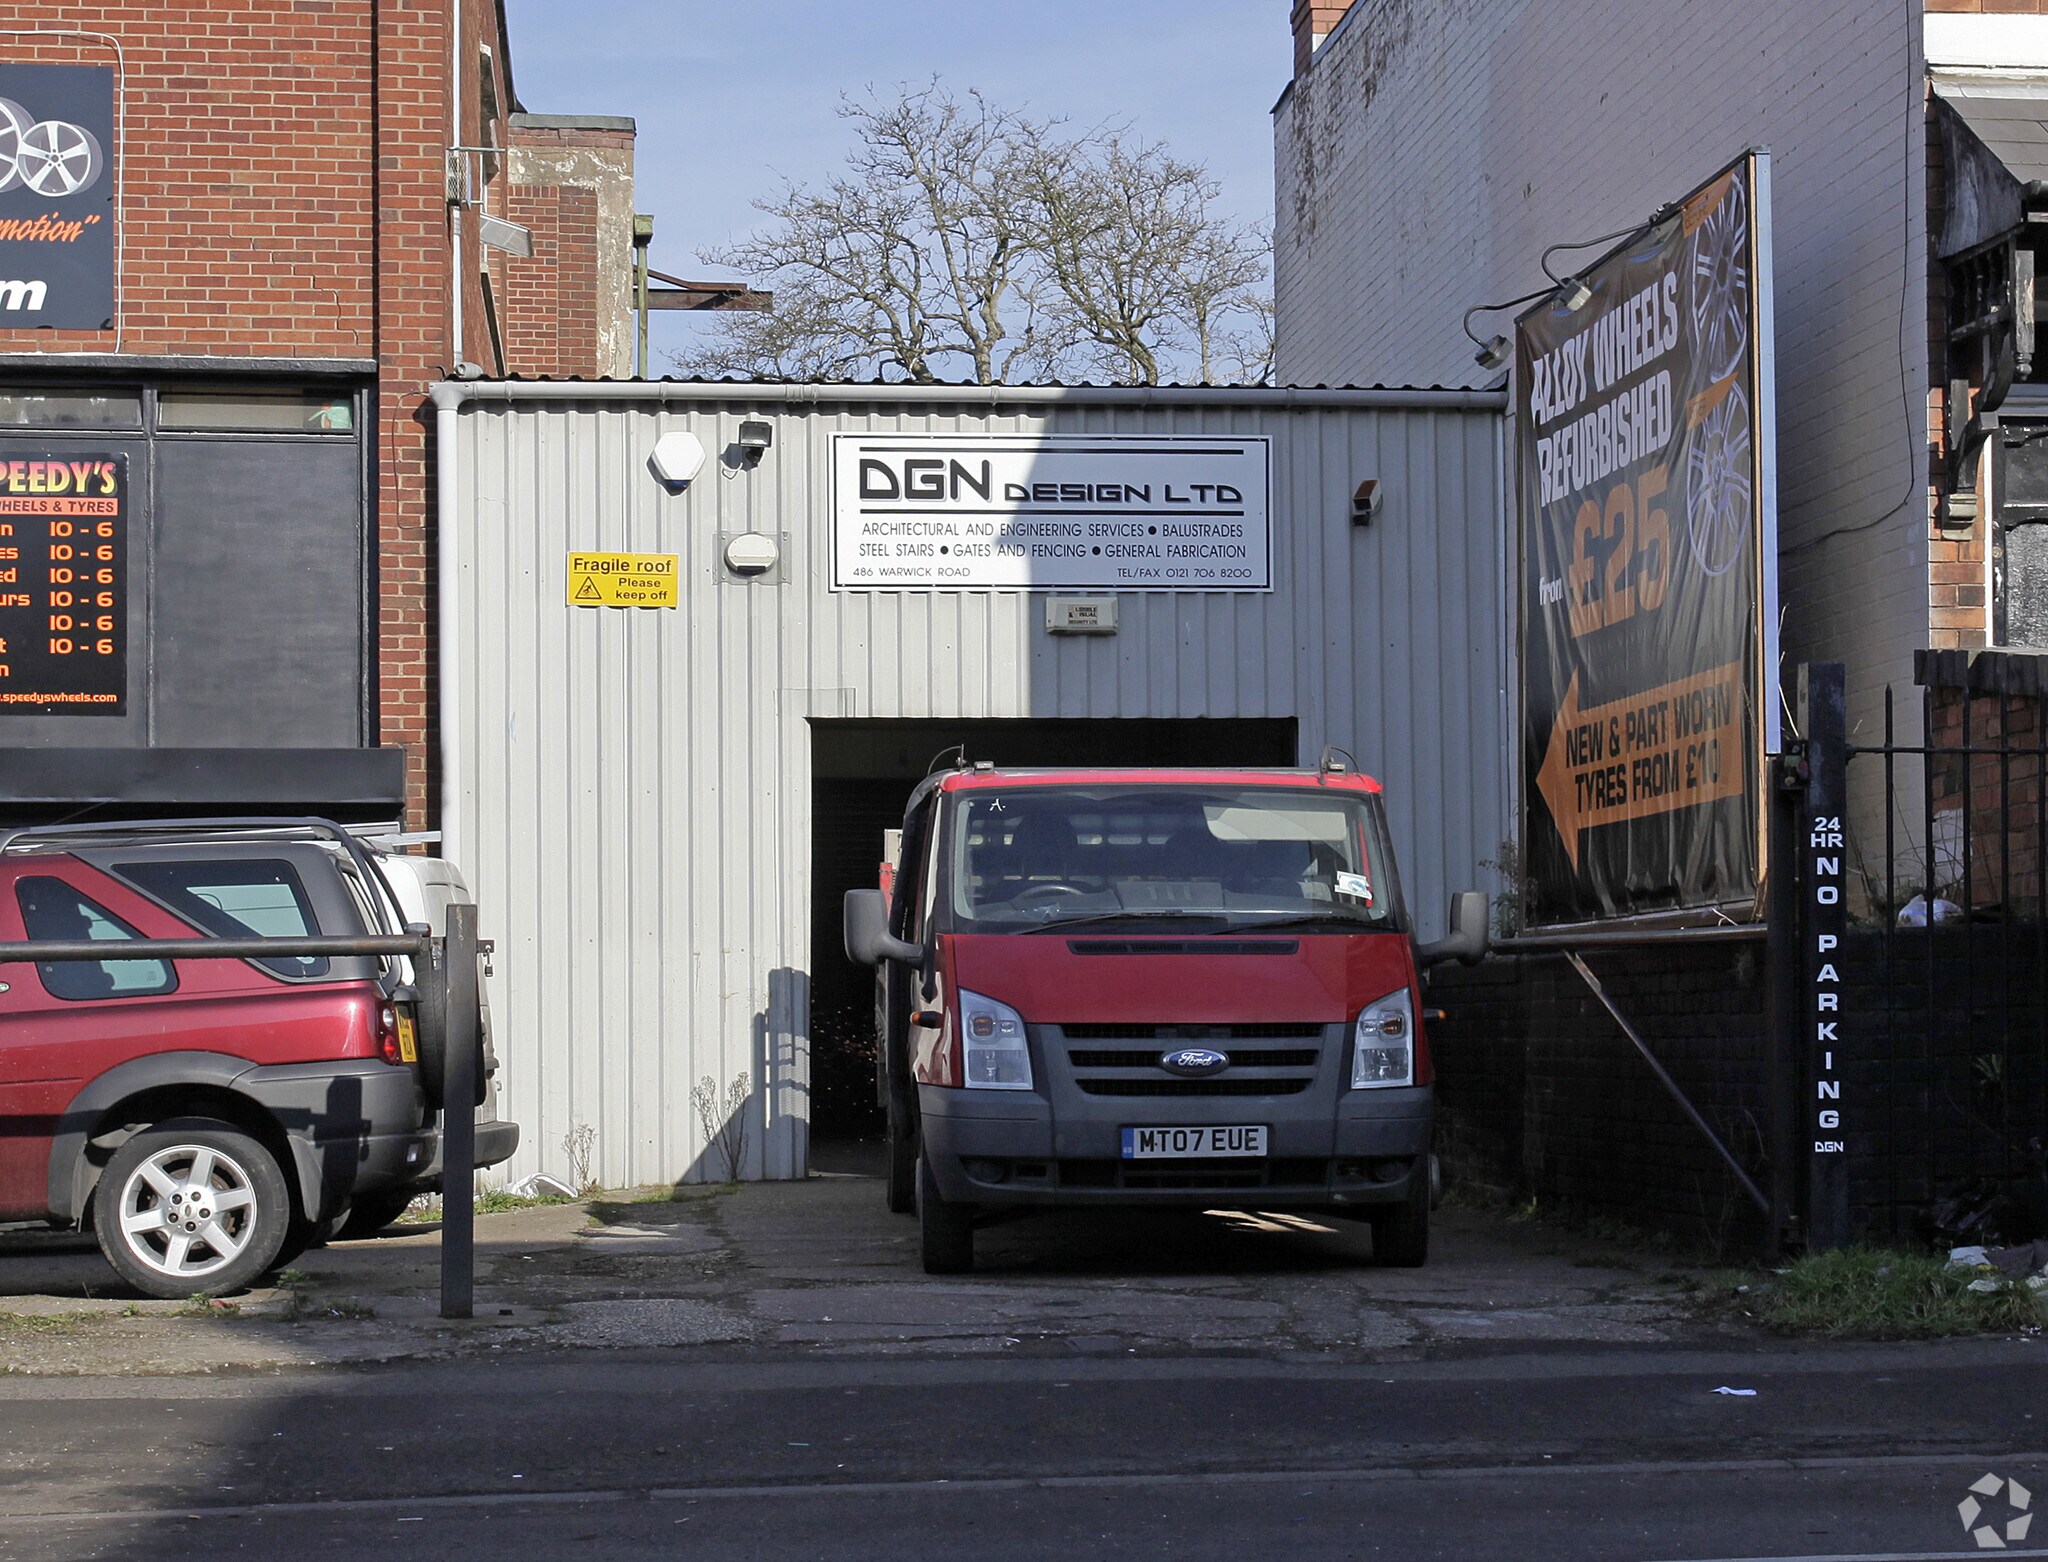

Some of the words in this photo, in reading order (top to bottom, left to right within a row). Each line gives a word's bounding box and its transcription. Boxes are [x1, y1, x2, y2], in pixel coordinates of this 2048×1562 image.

[1531, 328, 1589, 428] ALLOY
[1593, 271, 1678, 392] WHEELS
[1537, 369, 1672, 507] REFURBISHED
[859, 458, 991, 501] DGN
[1005, 483, 1151, 502] DESIGN
[1165, 484, 1243, 503] LTD
[0, 501, 48, 512] HEELS
[53, 501, 62, 512] &
[68, 501, 114, 513] TYRES
[50, 522, 73, 536] 10
[97, 522, 114, 538] 6
[862, 522, 959, 536] ARCHITECTURAL
[966, 523, 994, 536] AND
[1000, 523, 1082, 537] ENGINEERING
[1088, 523, 1144, 537] SERVICES
[1162, 524, 1243, 538] BALUSTRADES
[50, 544, 73, 560] 10
[97, 544, 114, 560] 6
[859, 543, 890, 557] STEEL
[896, 543, 935, 557] STAIRS
[953, 544, 991, 557] GATES
[997, 544, 1025, 557] AND
[1032, 544, 1086, 558] FENCING
[1105, 544, 1160, 558] GENERAL
[1167, 545, 1246, 558] FABRICATION
[1568, 463, 1670, 638] £25
[573, 558, 630, 575] Fragile
[637, 560, 671, 573] roof
[853, 567, 874, 577] 486
[879, 567, 932, 577] WARWICK
[937, 568, 971, 577] ROAD
[1117, 568, 1161, 578] TEL/FAX
[1166, 568, 1189, 578] 0121
[1193, 568, 1215, 578] 706
[1220, 568, 1252, 578] 8200
[50, 568, 73, 583] 10
[97, 568, 114, 584] 6
[618, 577, 661, 588] Please
[50, 592, 73, 606] 10
[97, 592, 114, 608] 6
[615, 590, 647, 601] keep
[650, 590, 668, 600] off
[50, 615, 73, 630] 10
[97, 615, 114, 631] 6
[50, 638, 73, 654] 10
[97, 638, 114, 654] 6
[0, 692, 117, 704] .speedyswheels.com
[1566, 720, 1604, 769] NEW
[1609, 716, 1620, 758] &
[1626, 701, 1668, 753] PART
[1673, 683, 1731, 740] WORN
[1575, 763, 1628, 813] TYRES
[1633, 750, 1680, 801] FROM
[1686, 738, 1722, 789] £10
[1814, 816, 1841, 831] 24
[1810, 833, 1844, 848] HR
[1816, 857, 1839, 904] NO
[1816, 934, 1840, 1129] PARKING
[1178, 1052, 1213, 1067] Ford
[1139, 1129, 1204, 1152] MT07
[1211, 1128, 1259, 1151] EUE
[1814, 1141, 1844, 1152] DGN
